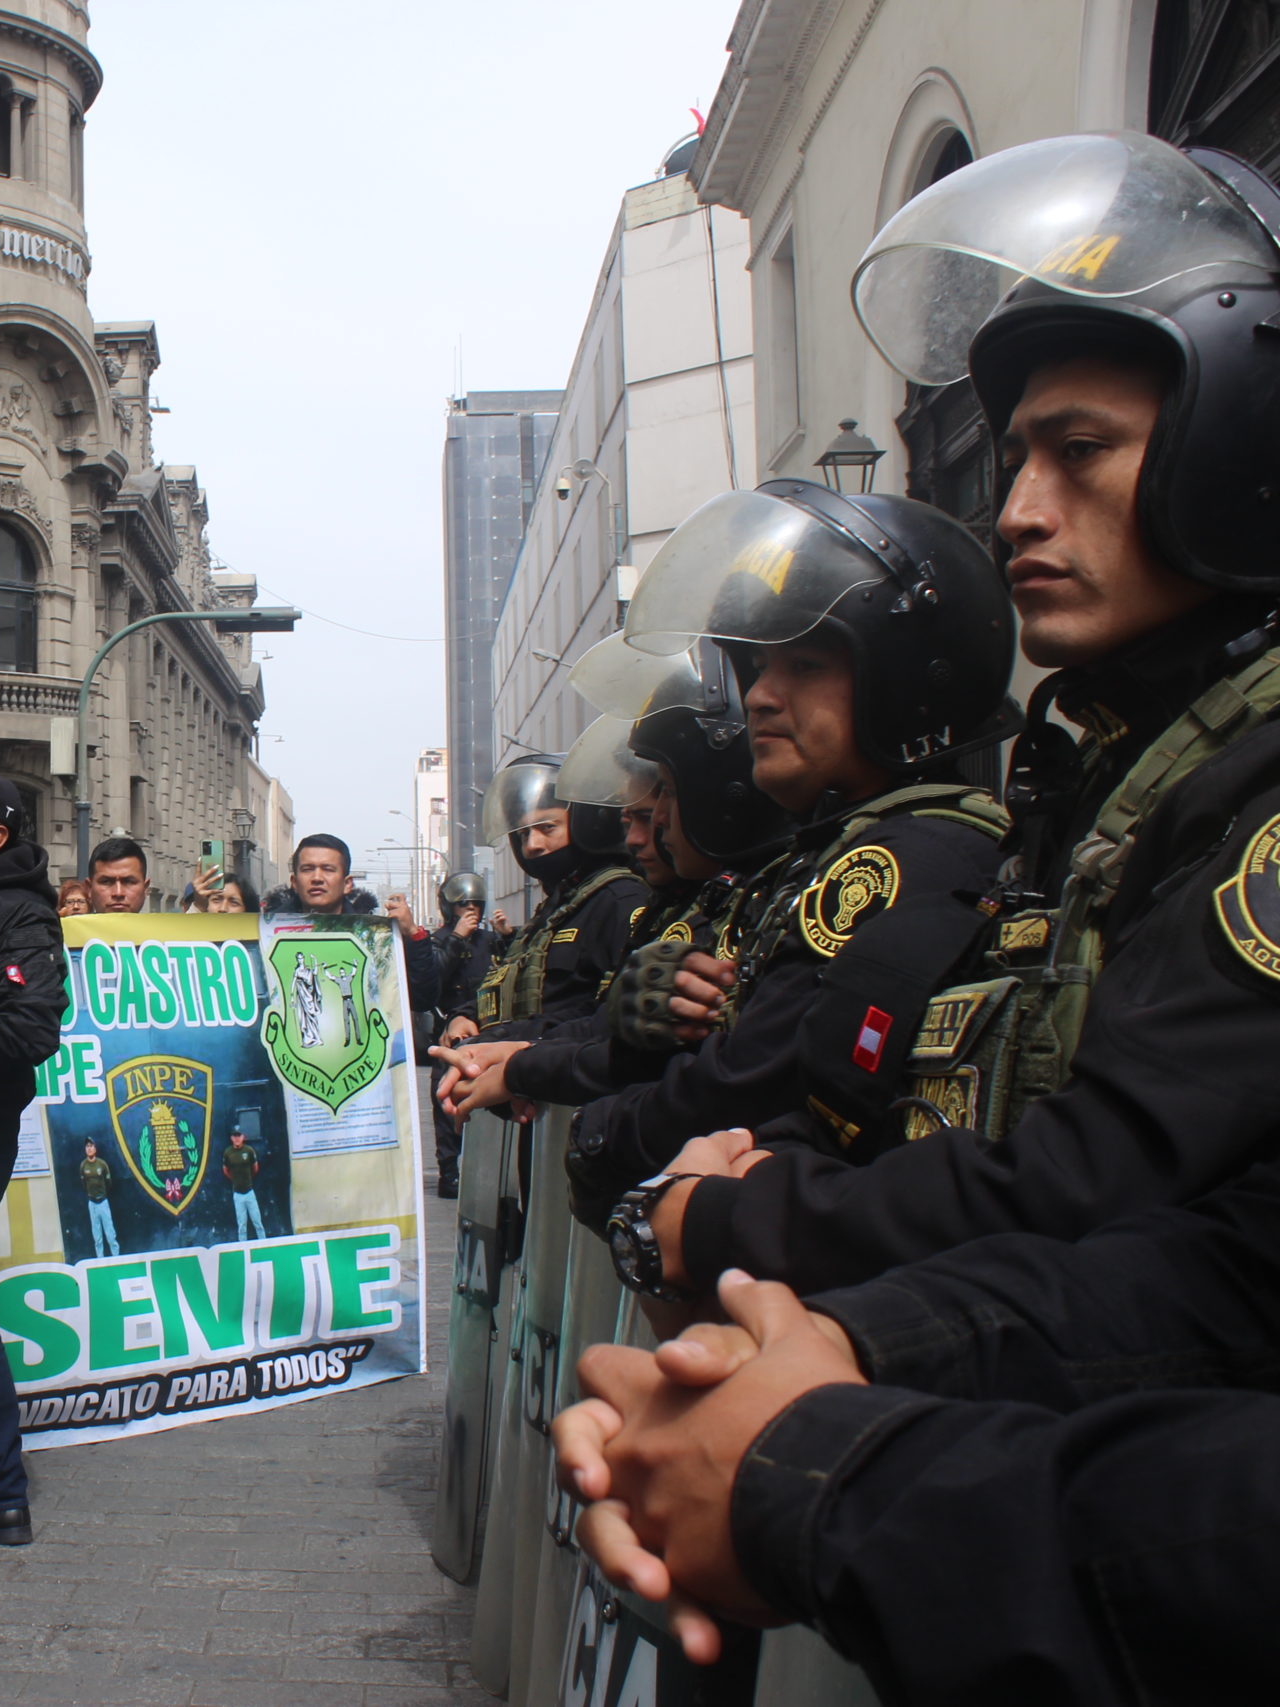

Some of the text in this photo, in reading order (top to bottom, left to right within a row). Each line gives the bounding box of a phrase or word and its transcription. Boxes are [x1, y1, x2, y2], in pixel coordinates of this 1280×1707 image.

[84, 943, 256, 1026] CASTRO
[124, 1064, 195, 1101] INPE
[278, 1053, 378, 1097] SINTRAP INPE
[167, 1366, 248, 1408] PARA
